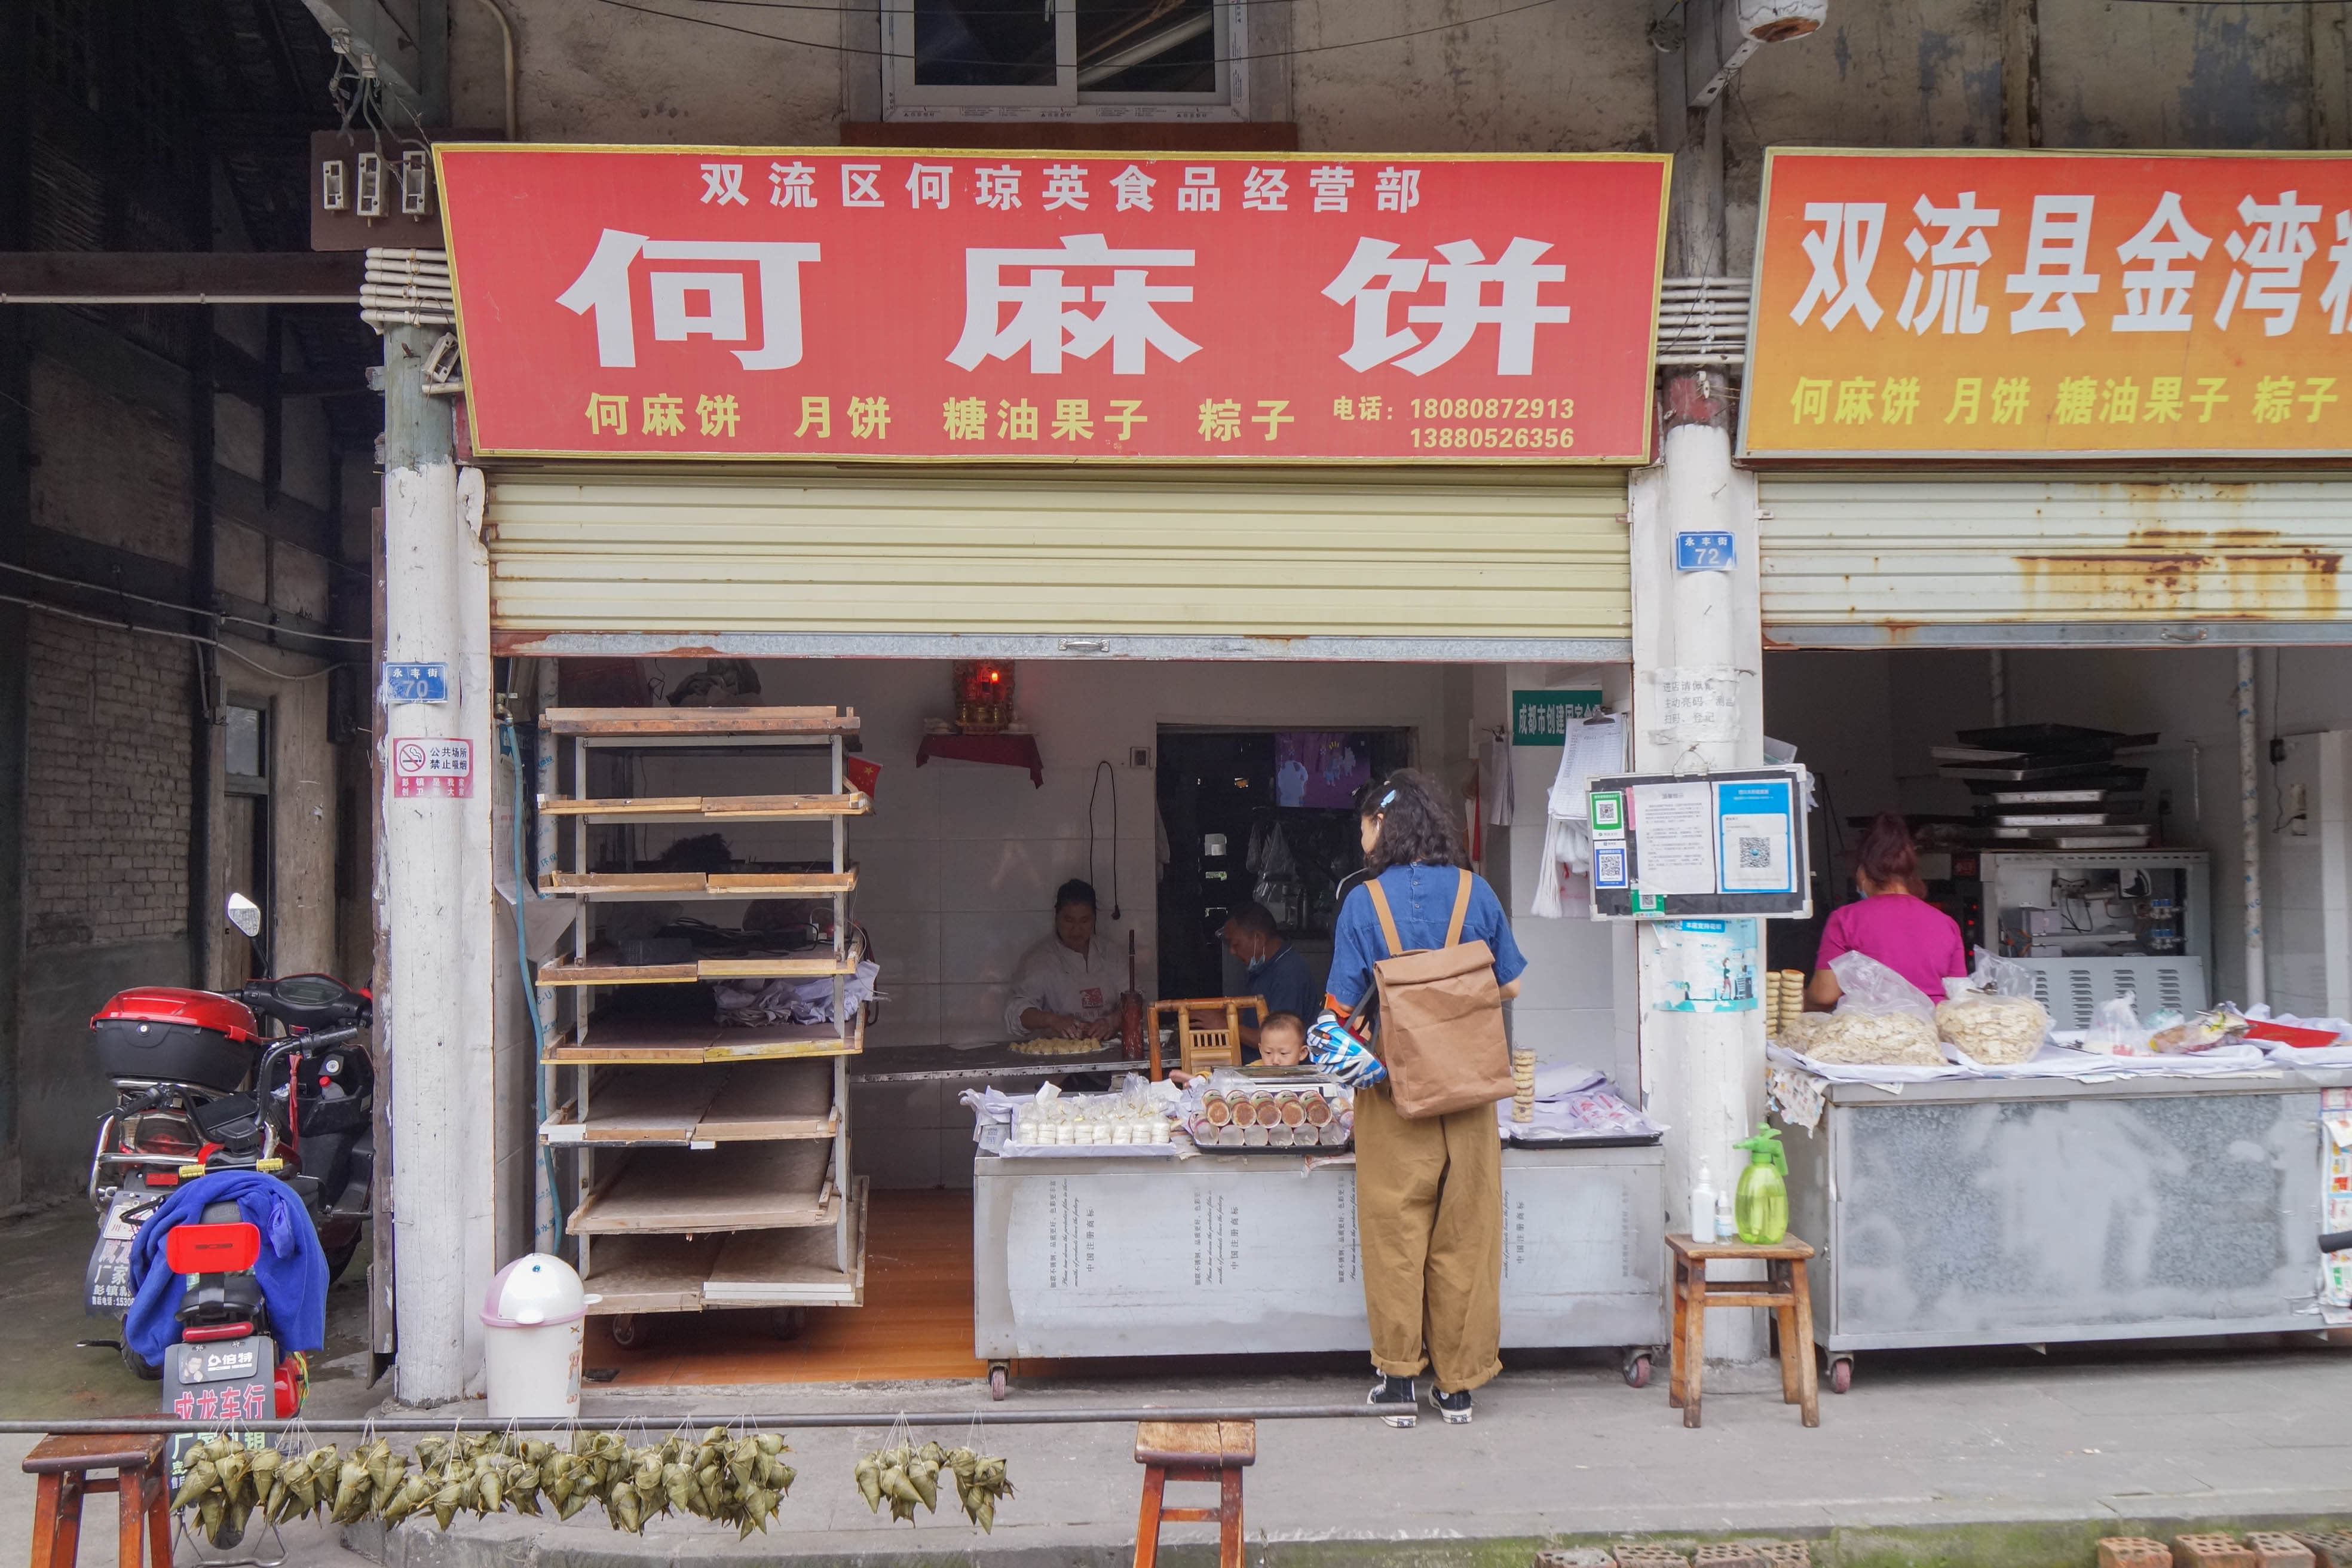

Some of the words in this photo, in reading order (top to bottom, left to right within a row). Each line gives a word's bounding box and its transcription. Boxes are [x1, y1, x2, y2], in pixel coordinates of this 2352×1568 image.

[700, 161, 1421, 213] 双流区何琼英食品经营部
[556, 228, 1570, 376] 何麻饼
[1411, 398, 1574, 419] 18080872913
[1790, 376, 1920, 425] 何麻饼
[1945, 377, 2031, 425] 月饼
[2054, 376, 2230, 425] 糖油果子
[2252, 375, 2339, 424] 粽子
[586, 392, 740, 437] 何麻饼
[795, 396, 891, 439] 月饼
[943, 396, 1148, 441] 糖油果子
[1198, 398, 1295, 442] 粽子
[1411, 427, 1574, 448] 13880526356
[1685, 537, 1728, 546] 永丰街
[1695, 548, 1719, 565] 72
[393, 668, 438, 679] 永丰街
[402, 680, 428, 697] 70
[430, 747, 467, 758] 公共场所
[430, 760, 467, 770] 禁止吸烟
[402, 788, 464, 797] 创卫大家
[1230, 1206, 1239, 1269] 中国注册商标
[174, 1383, 266, 1420] 成龙车行
